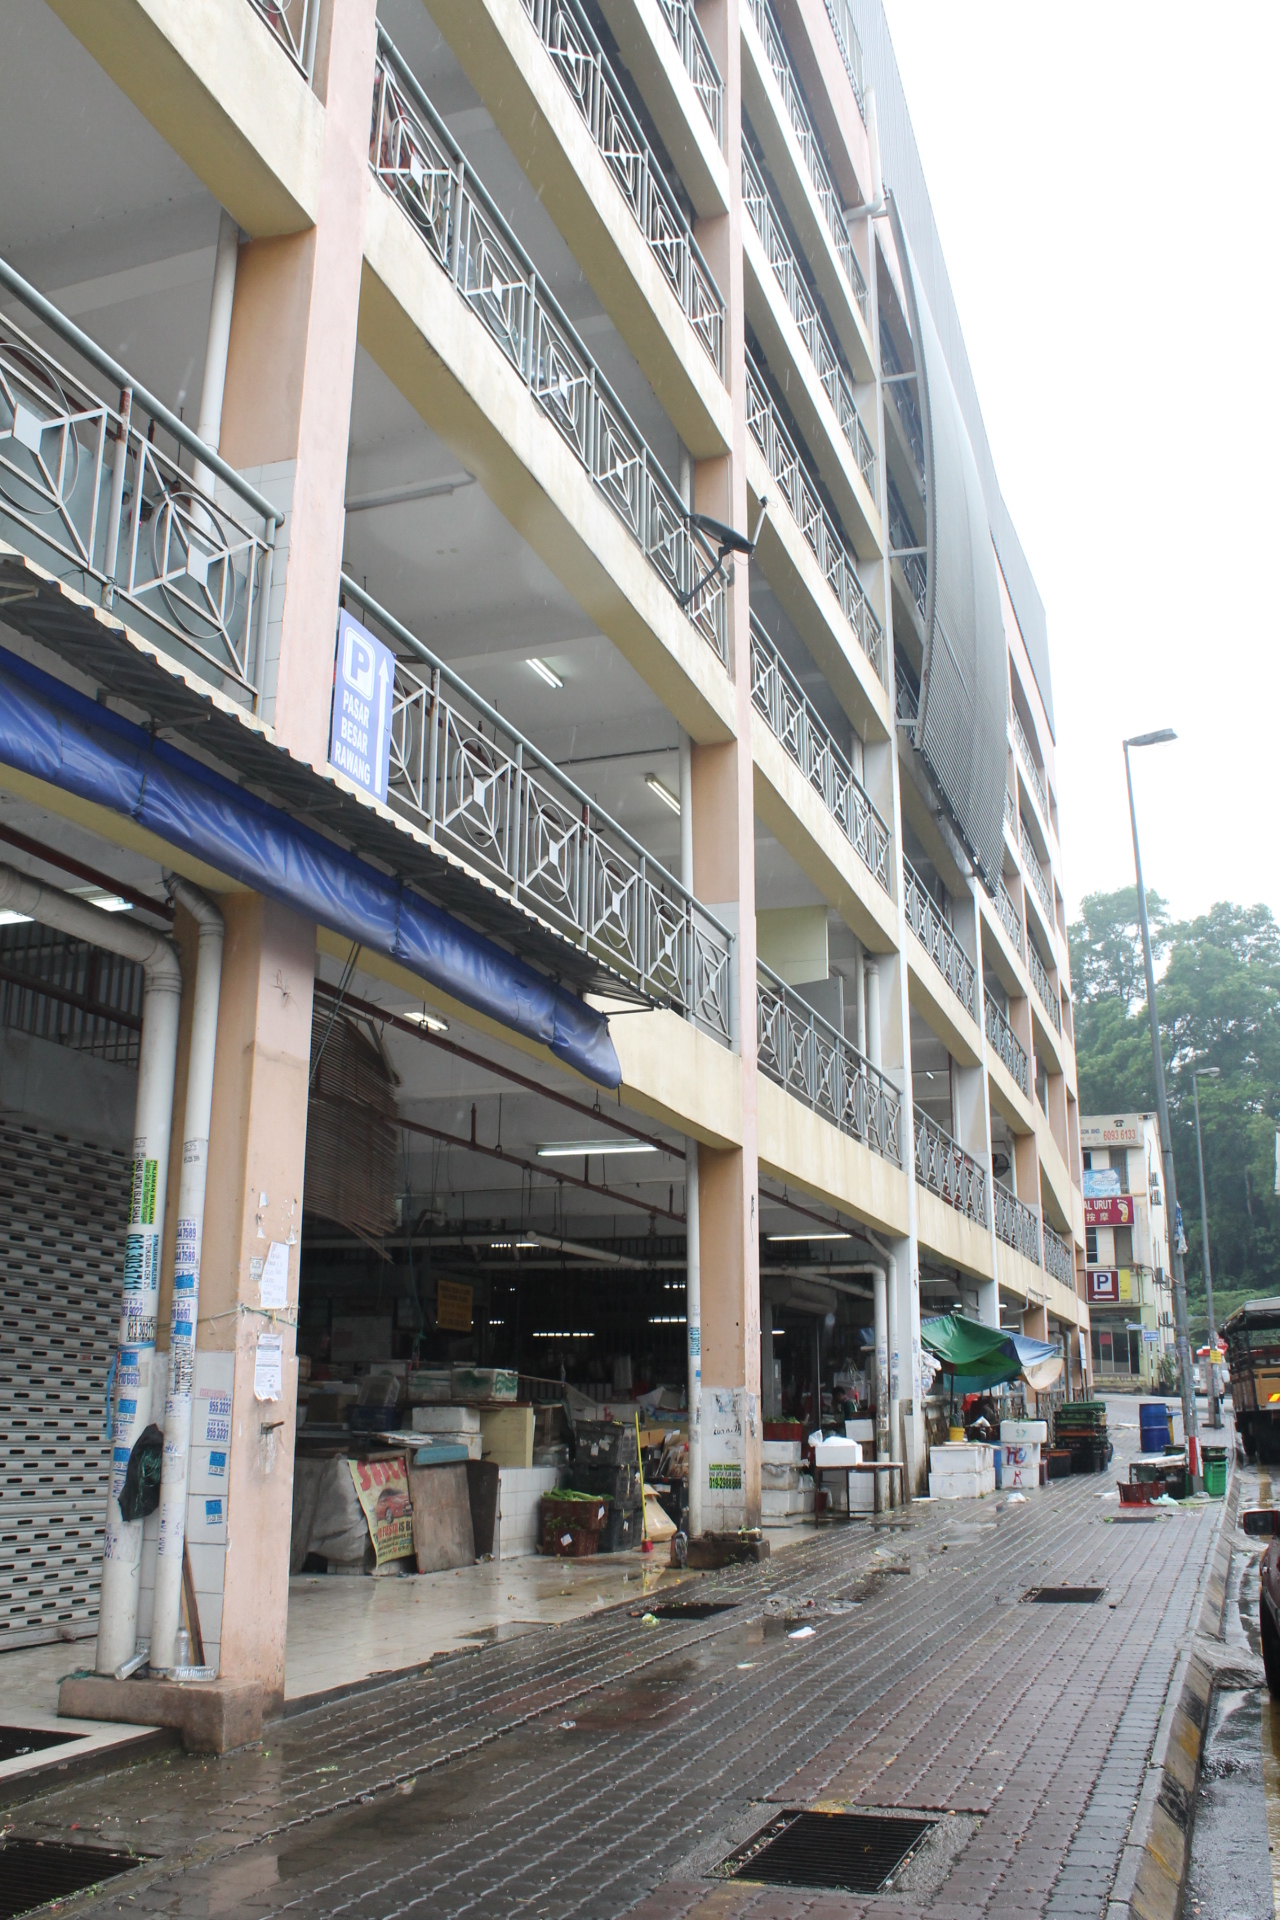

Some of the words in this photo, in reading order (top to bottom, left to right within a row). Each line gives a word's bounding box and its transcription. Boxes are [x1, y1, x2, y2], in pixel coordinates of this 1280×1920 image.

[350, 639, 370, 681] P
[342, 689, 370, 729] PASAR
[340, 715, 368, 757] BESAR
[334, 740, 371, 786] RAWANG
[1103, 1130, 1119, 1141] 6093
[1120, 1129, 1136, 1140] 6133
[1094, 1199, 1113, 1210] URUT
[126, 1234, 144, 1250] 013
[123, 1253, 143, 1290] 3031711
[1096, 1274, 1109, 1289] P
